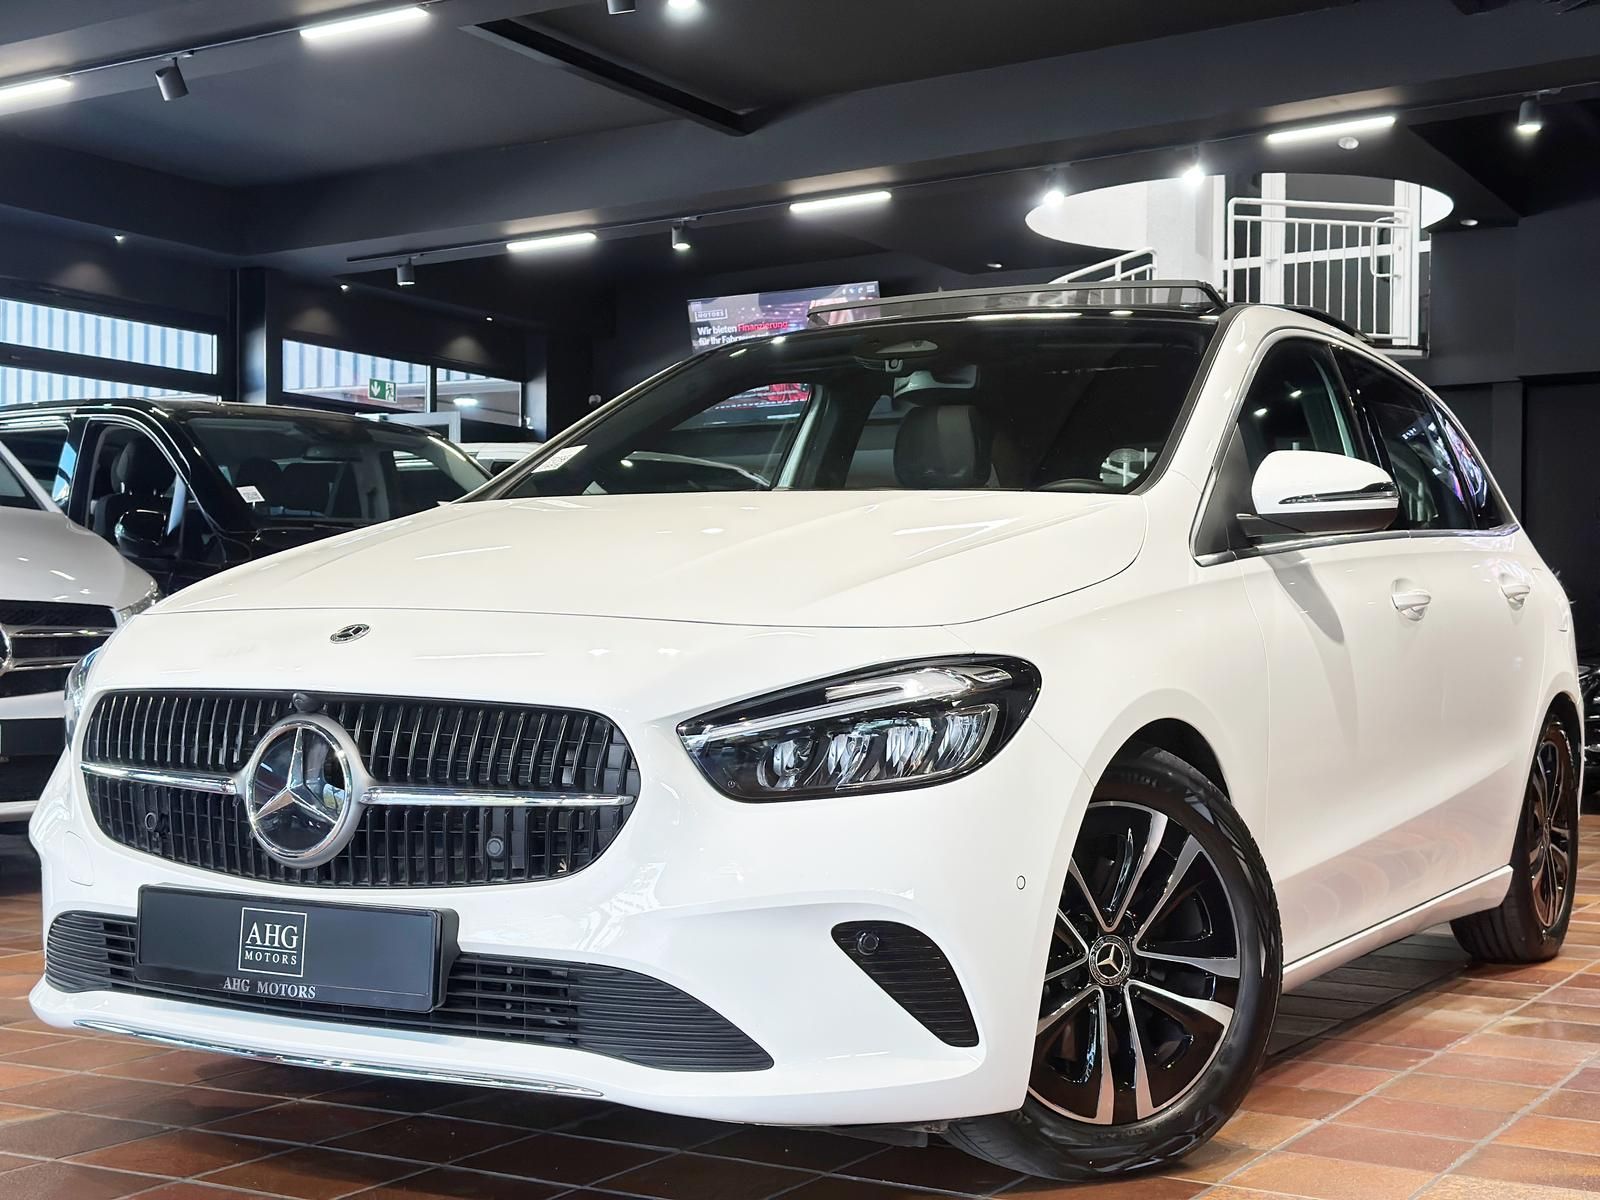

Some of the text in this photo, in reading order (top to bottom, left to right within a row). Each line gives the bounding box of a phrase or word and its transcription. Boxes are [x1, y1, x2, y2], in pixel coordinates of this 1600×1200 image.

[697, 321, 788, 336] Wir bieten Finanzierung
[698, 337, 710, 346] für
[711, 336, 722, 345] Ihr
[245, 921, 299, 949] AHG
[244, 950, 297, 965] MOTORS
[223, 976, 316, 999] AHG MOTORS
